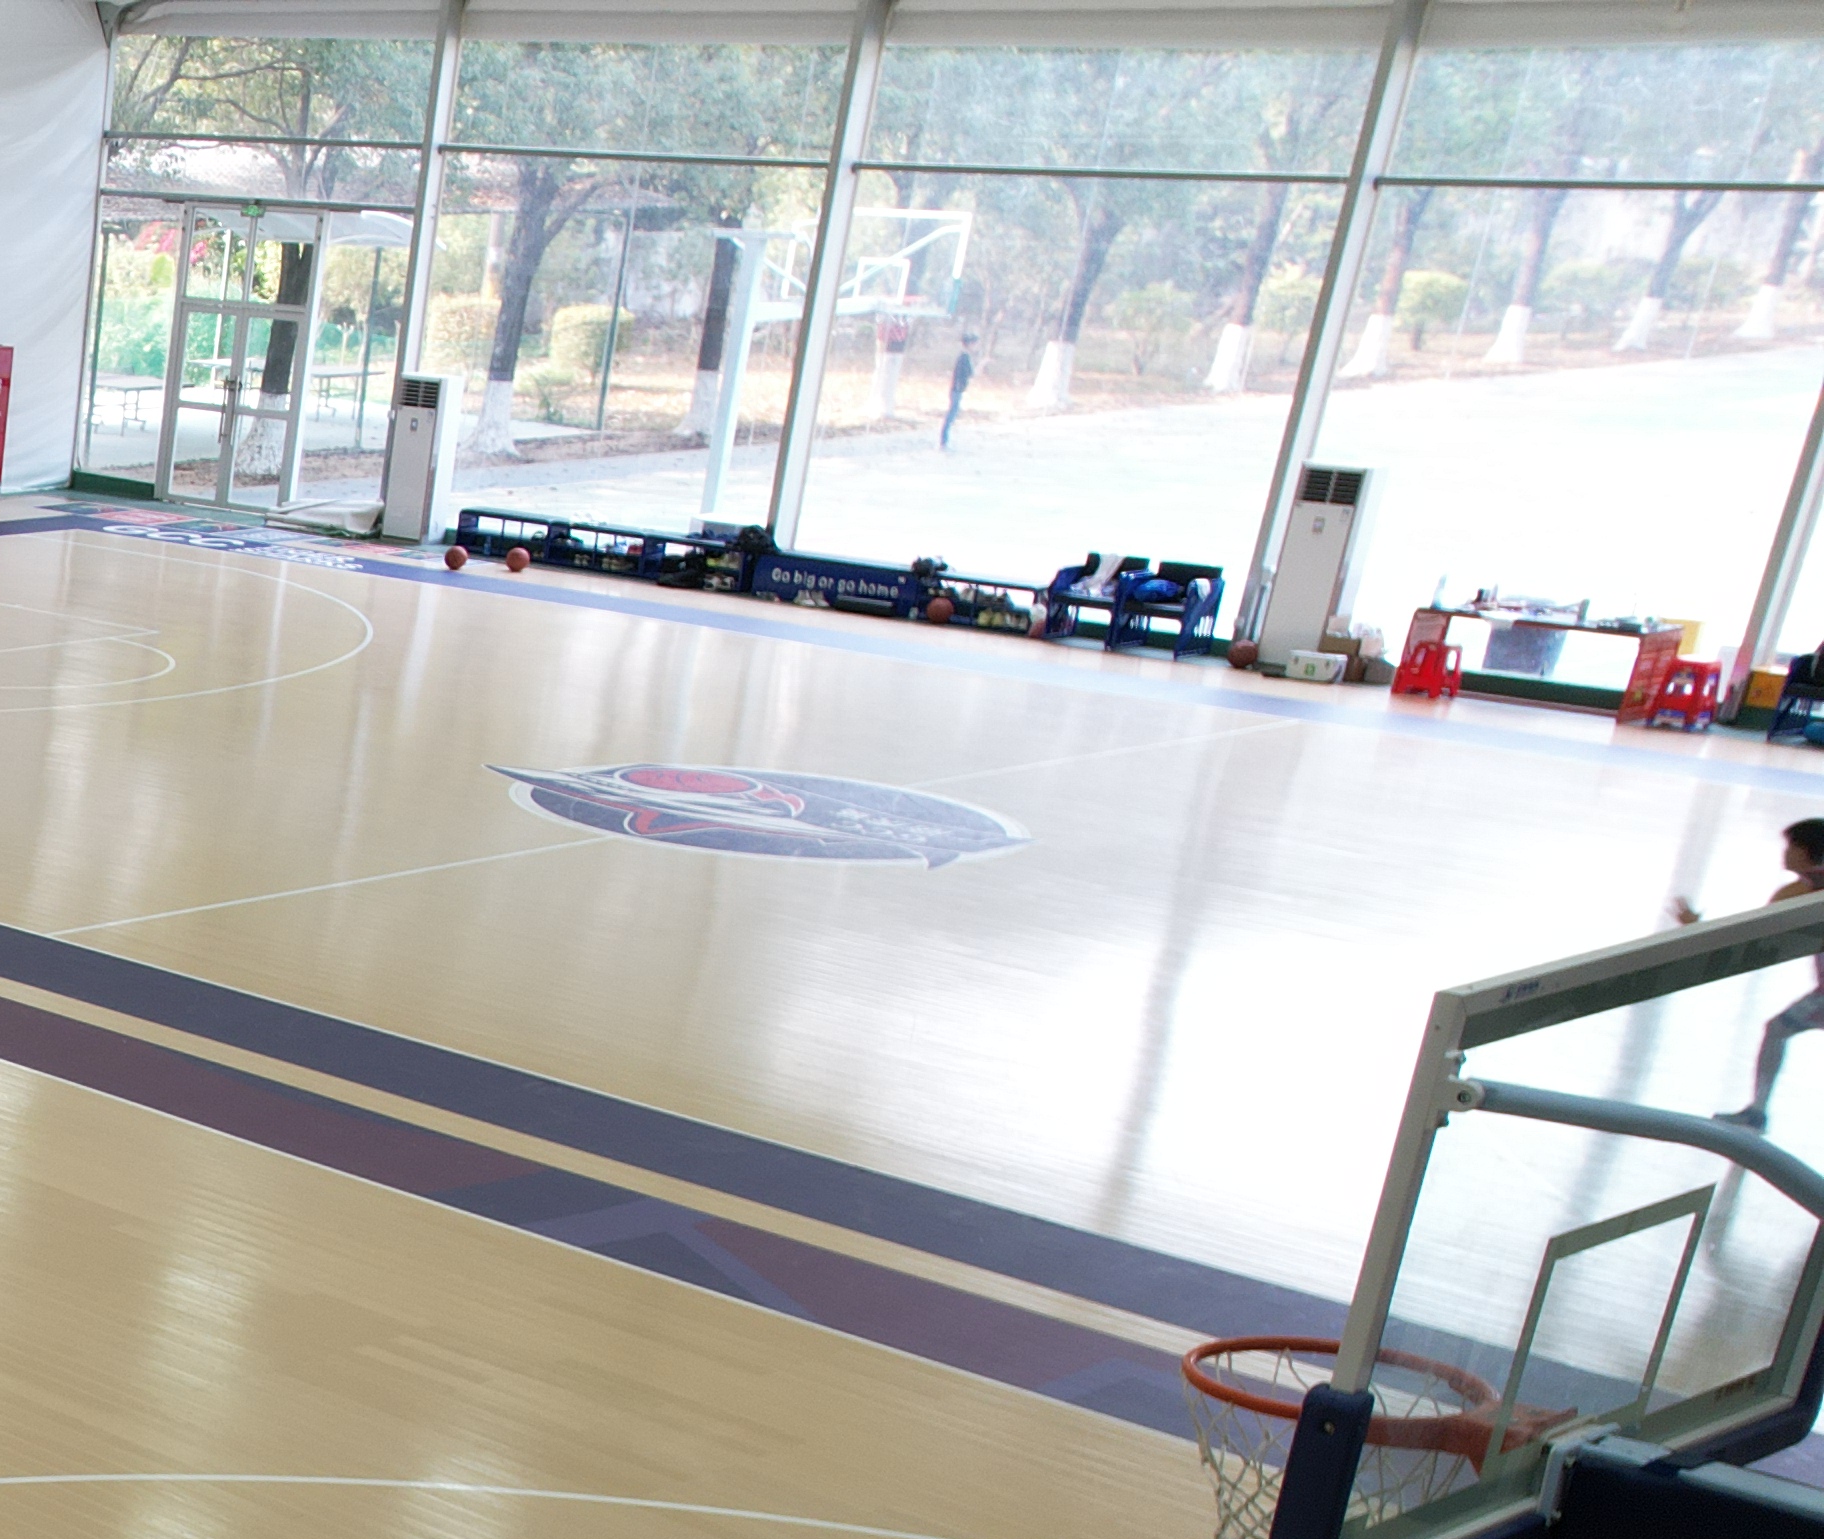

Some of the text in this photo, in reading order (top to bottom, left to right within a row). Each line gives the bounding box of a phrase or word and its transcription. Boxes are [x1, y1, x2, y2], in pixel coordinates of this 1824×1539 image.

[103, 525, 245, 547] GCC
[771, 567, 791, 584] Go
[793, 570, 816, 590] big
[818, 575, 834, 590] or
[837, 579, 856, 593] go
